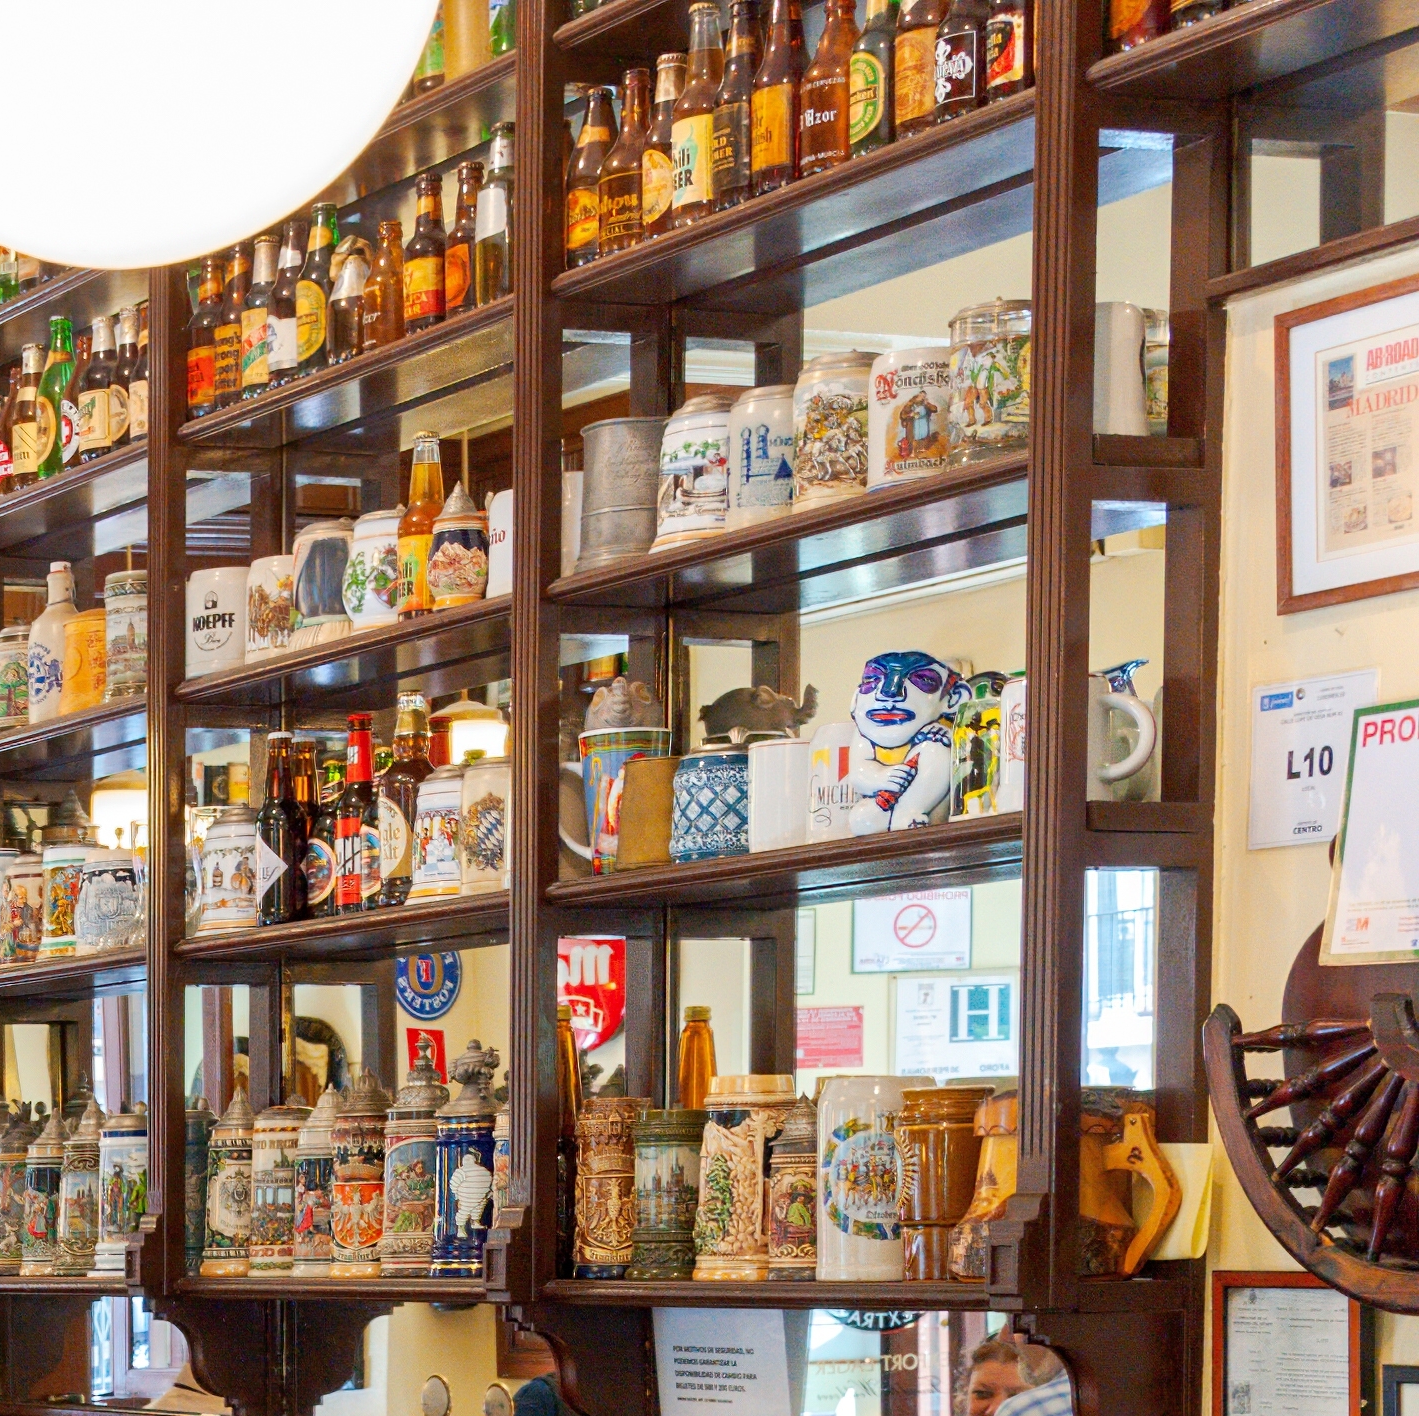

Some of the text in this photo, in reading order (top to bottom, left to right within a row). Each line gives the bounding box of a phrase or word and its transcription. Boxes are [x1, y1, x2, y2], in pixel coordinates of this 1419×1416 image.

[1363, 710, 1419, 748] PRO
[1286, 744, 1333, 781] L10
[1292, 824, 1323, 836] CENTRO
